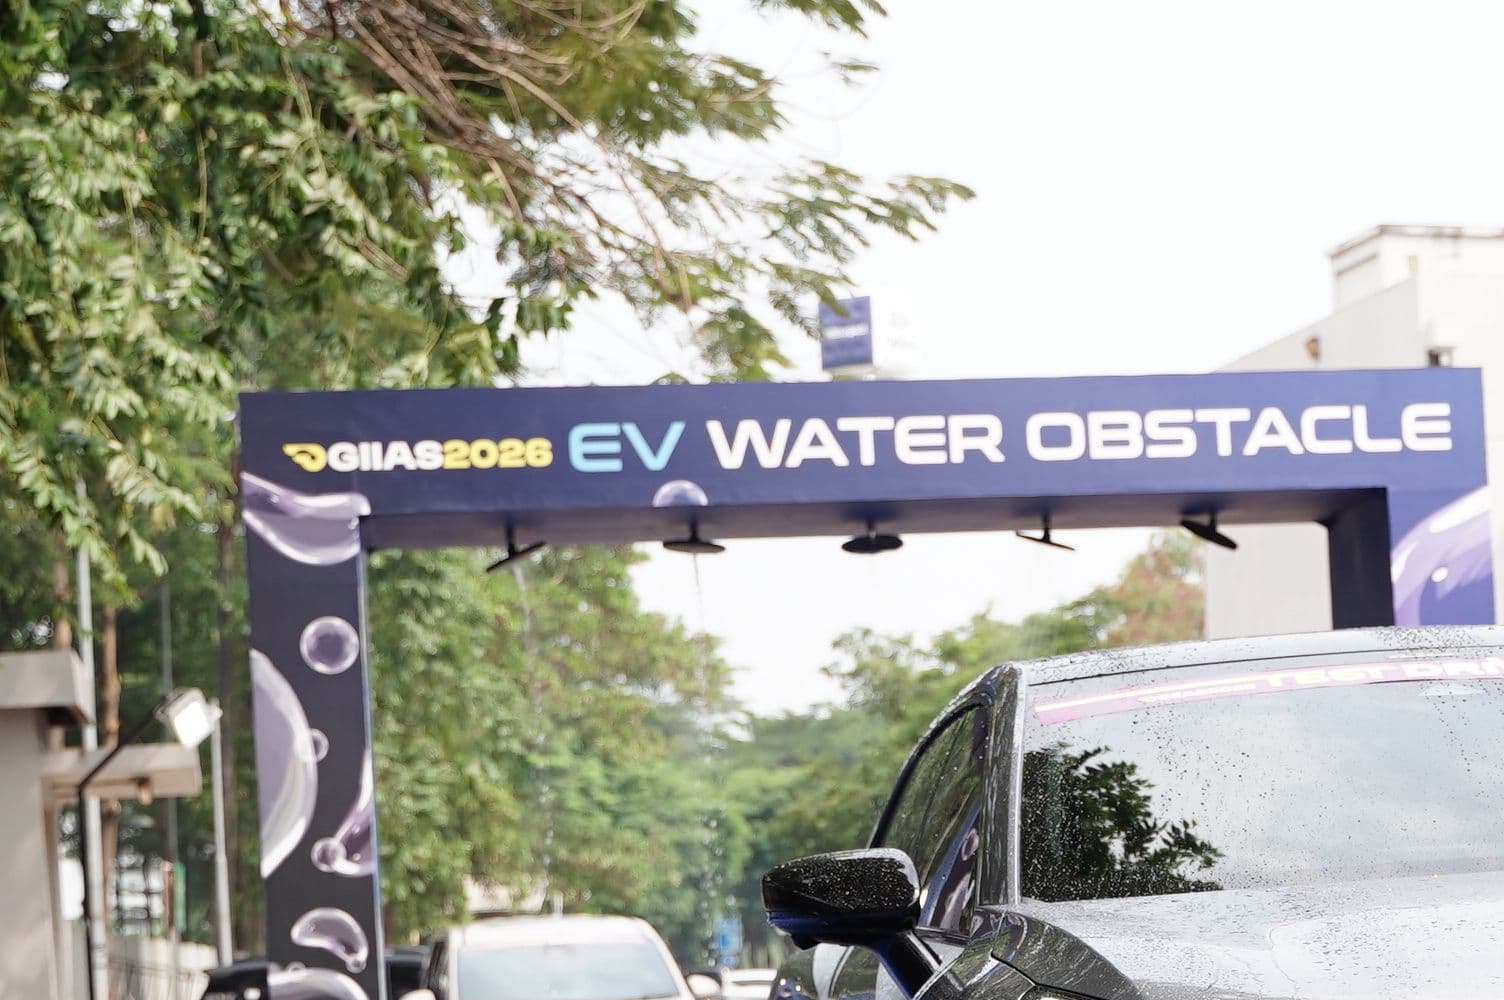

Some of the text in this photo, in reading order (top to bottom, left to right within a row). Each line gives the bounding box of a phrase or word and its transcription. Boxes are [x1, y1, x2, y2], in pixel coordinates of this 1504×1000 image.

[327, 402, 1453, 473] GIIAS2026 EV WATER OBSTACLE
[1266, 664, 1395, 688] TEST
